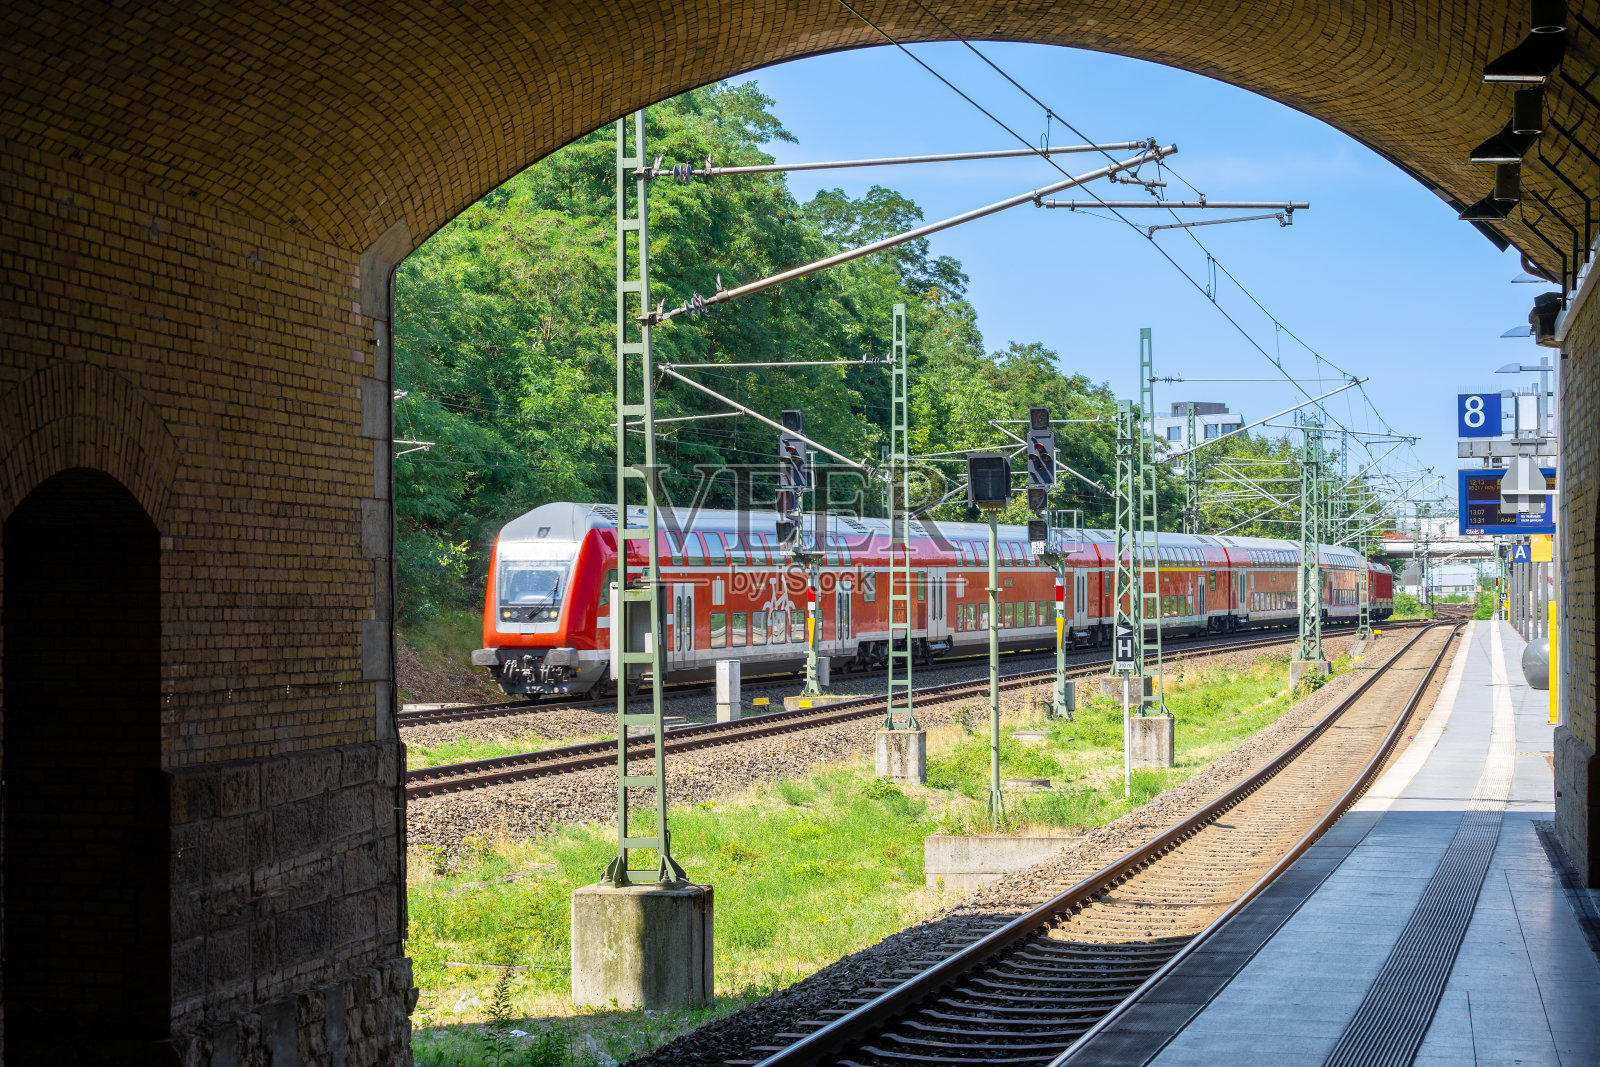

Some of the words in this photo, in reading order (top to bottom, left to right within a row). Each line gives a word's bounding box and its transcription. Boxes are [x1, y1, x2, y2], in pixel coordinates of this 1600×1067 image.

[1464, 396, 1486, 428] 8
[1514, 546, 1527, 559] A
[1117, 639, 1132, 658] H
